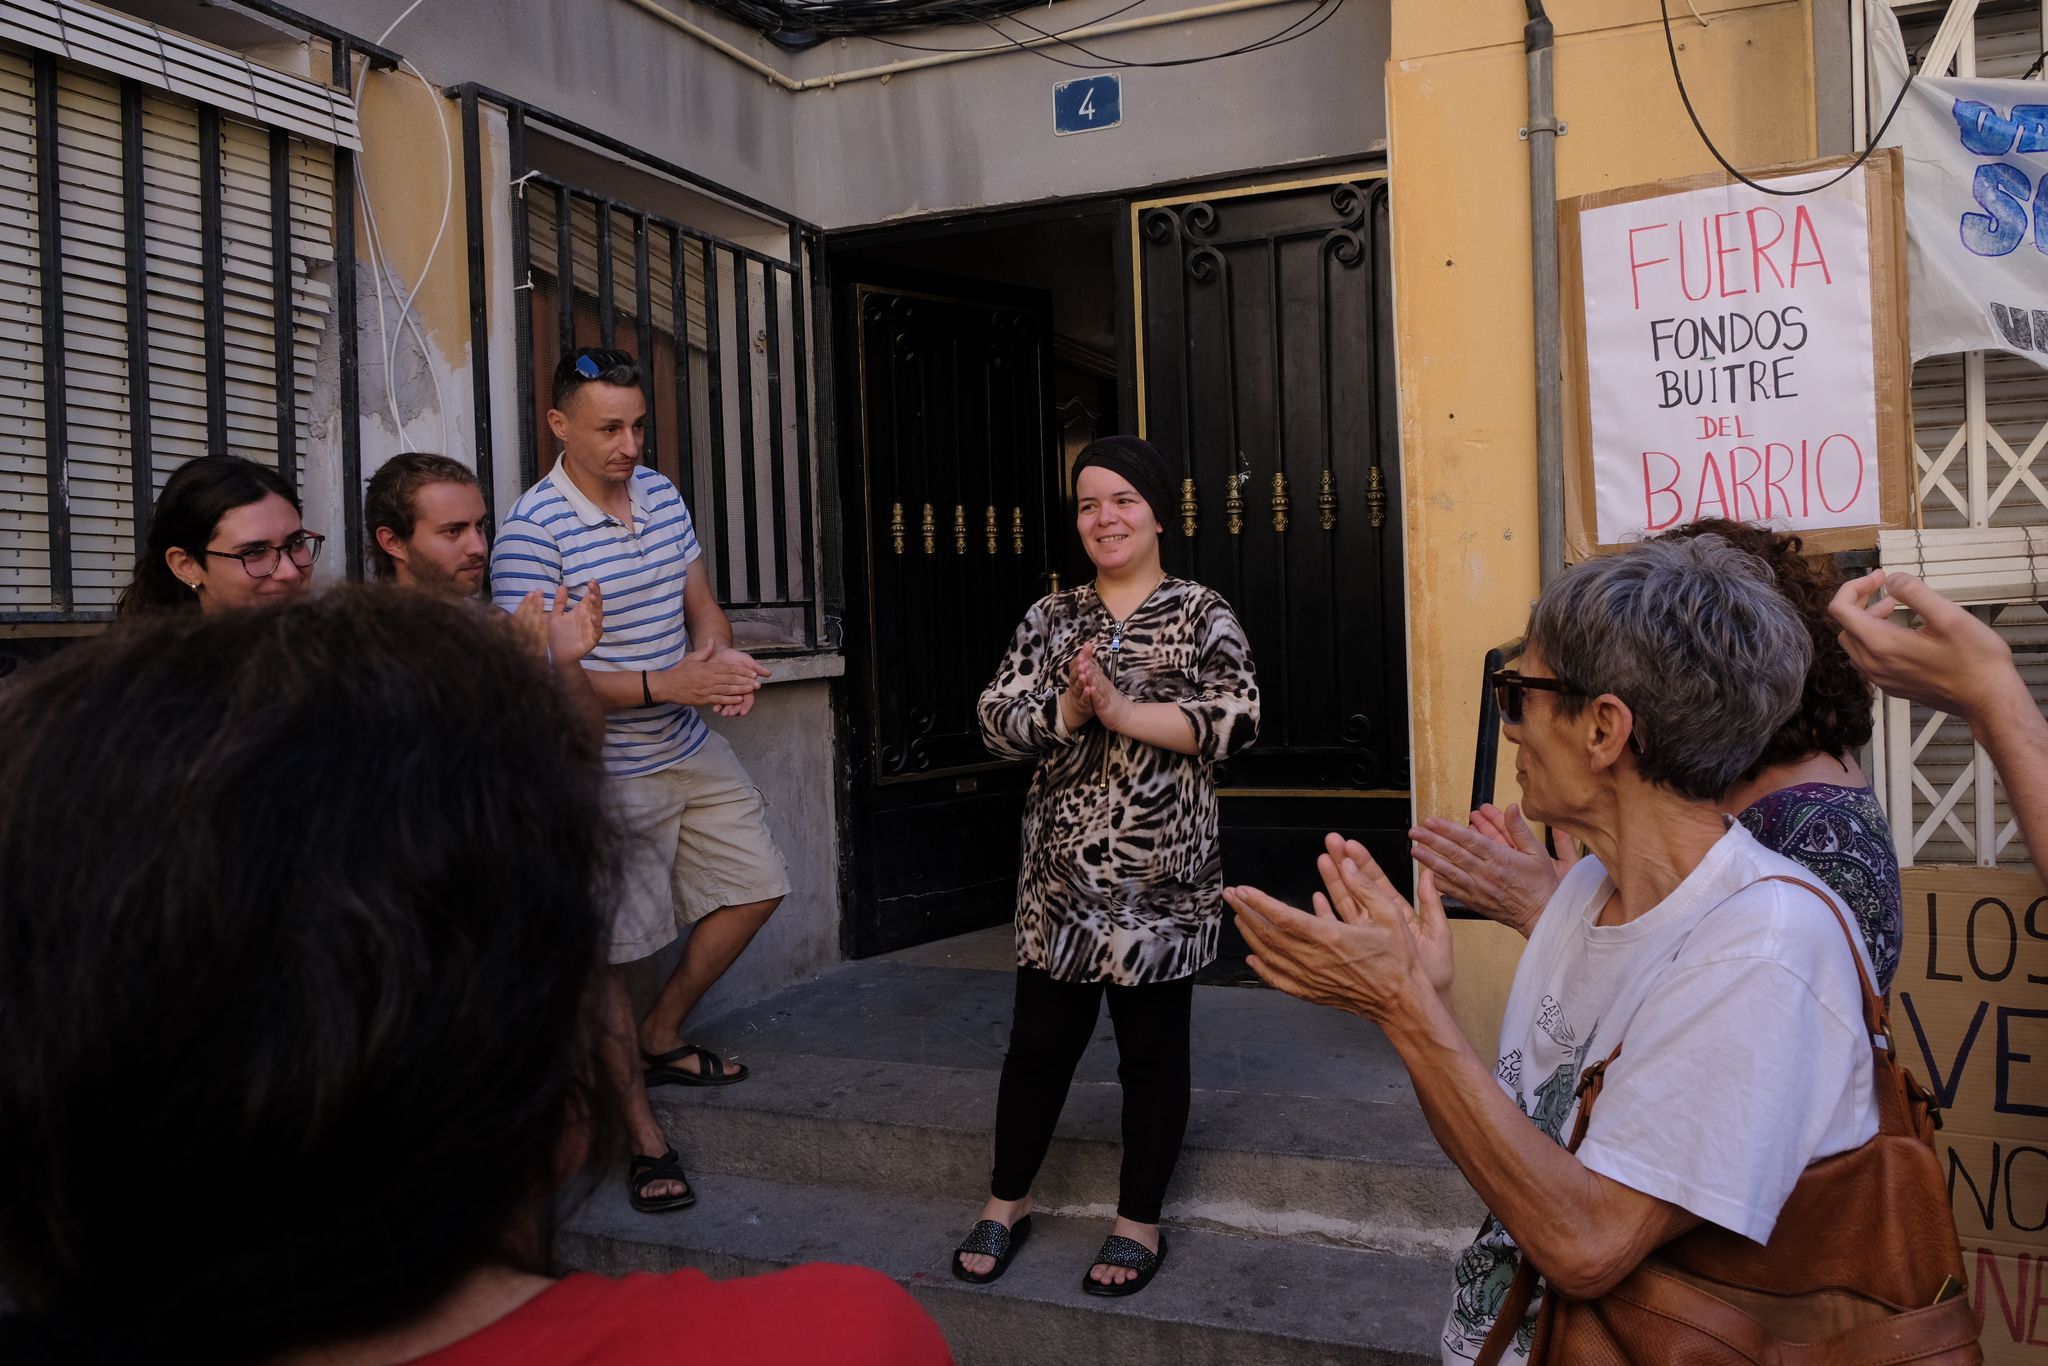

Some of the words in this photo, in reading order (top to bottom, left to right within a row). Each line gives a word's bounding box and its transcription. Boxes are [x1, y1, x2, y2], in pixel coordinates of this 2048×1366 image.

[1079, 87, 1096, 120] 4
[1960, 162, 2048, 257] S
[1628, 204, 1832, 309] FUERA
[1650, 305, 1808, 362] FONDOS
[1655, 356, 1799, 409] BUITRE
[1695, 415, 1755, 440] DEL
[1642, 433, 1864, 531] BARRIO
[1926, 892, 2048, 985] LOS
